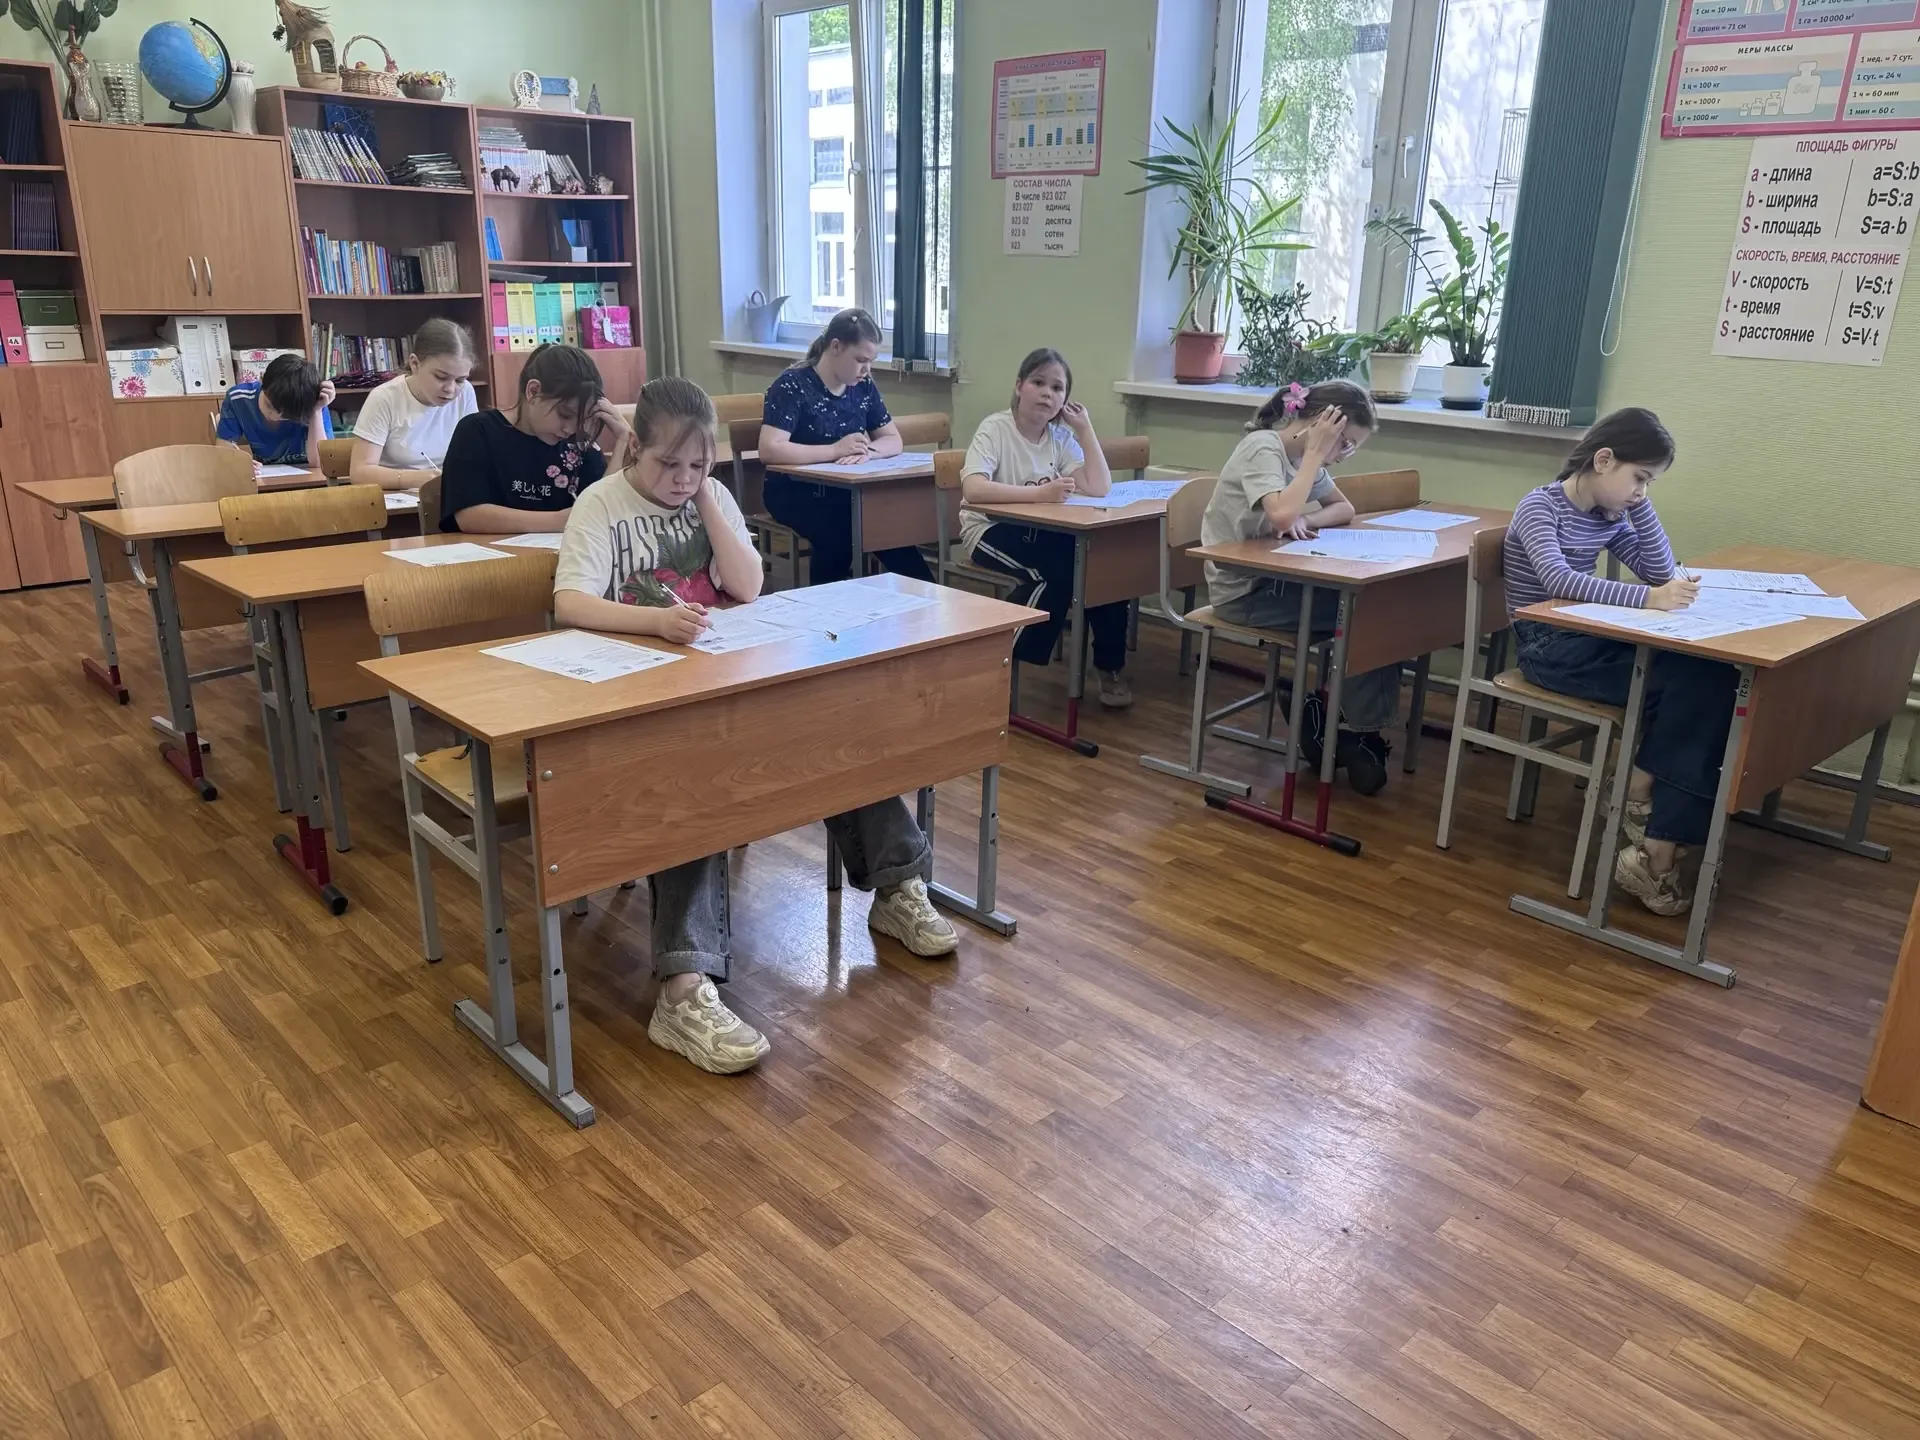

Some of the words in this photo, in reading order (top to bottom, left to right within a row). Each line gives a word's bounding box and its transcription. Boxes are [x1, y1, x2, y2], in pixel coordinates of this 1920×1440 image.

[1697, 26, 1720, 34] аршин
[1737, 46, 1762, 55] МЕРЫ
[1764, 44, 1794, 53] МАССЫ
[1899, 54, 1913, 62] сут.
[1701, 65, 1719, 73] 1000
[1878, 106, 1889, 114] 60
[1795, 139, 1849, 154] ПЛОЩАДЬ
[1852, 138, 1897, 151] ФИГУРЫ
[1769, 167, 1813, 185] длина
[1013, 179, 1043, 188] СОСТАВ
[1044, 179, 1072, 188] ЧИСЛА
[1015, 192, 1020, 201] В
[1021, 193, 1041, 201] числе
[1746, 190, 1754, 208] b
[1765, 193, 1819, 212] ширина
[1045, 204, 1071, 212] единиц
[1045, 218, 1072, 226] десятка
[1741, 216, 1751, 234] S
[1761, 220, 1822, 237] площадь
[1736, 249, 1789, 265] СКОРОСТЬ,
[1791, 251, 1828, 265] ВРЕМЯ,
[1830, 252, 1901, 265] РАССТОЯНИЕ
[1731, 270, 1741, 288] V
[1750, 275, 1809, 294] скорость
[1725, 296, 1731, 313] t
[1740, 300, 1781, 316] время
[1720, 320, 1730, 338] S
[1738, 325, 1815, 343] расстояние
[511, 479, 552, 497] 美しい花
